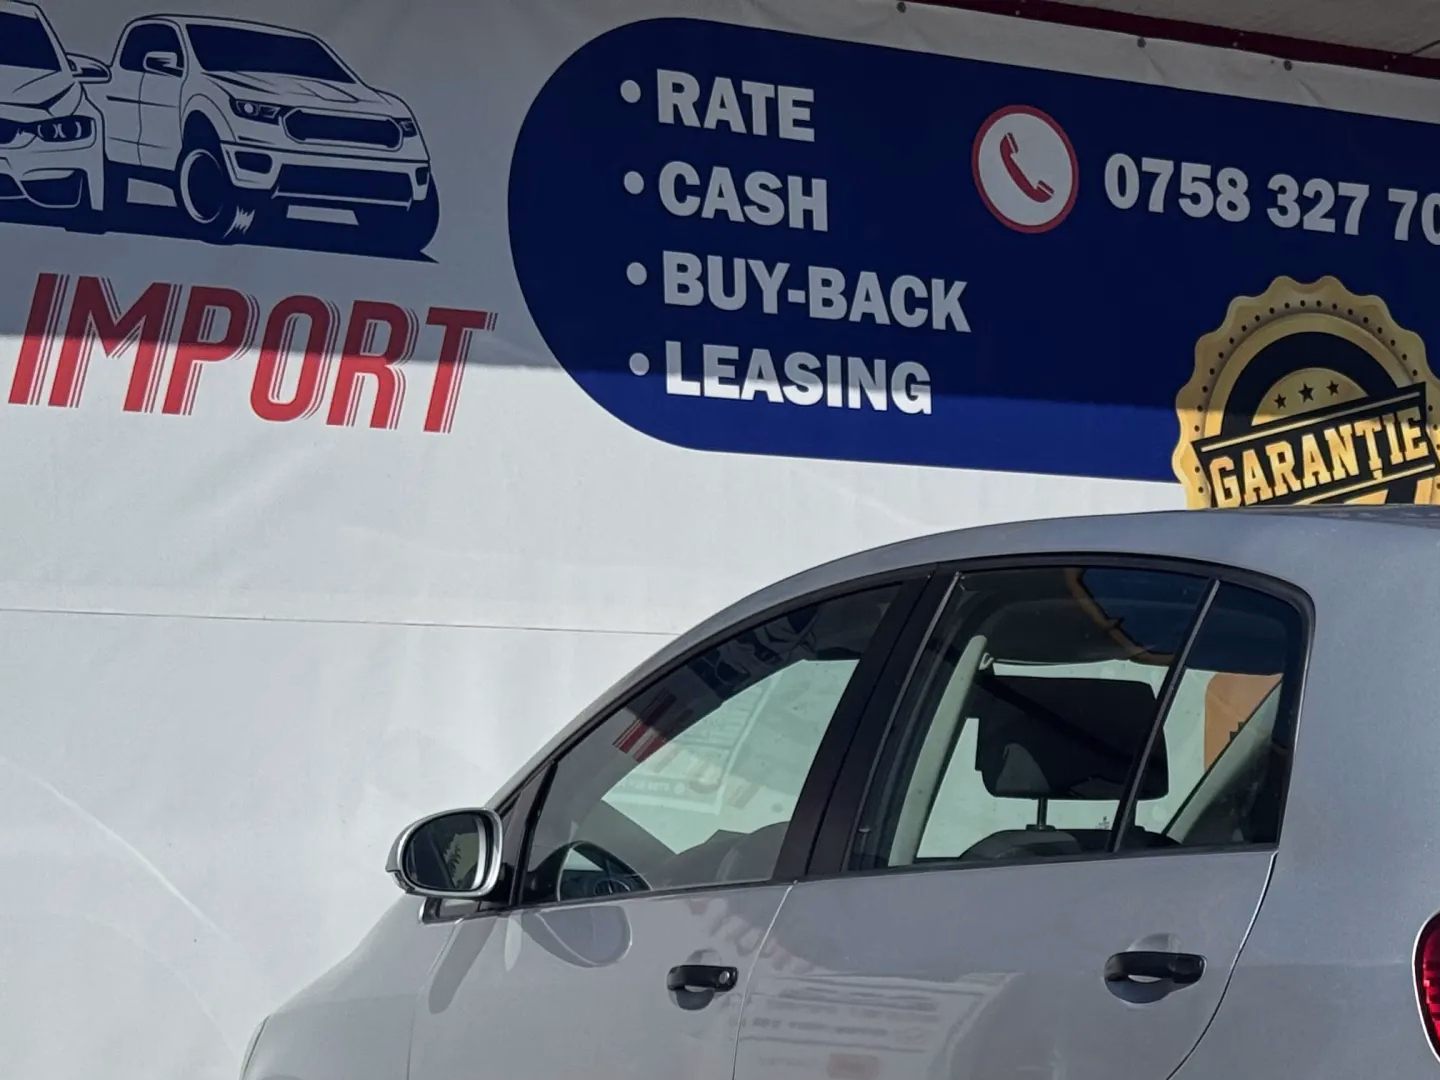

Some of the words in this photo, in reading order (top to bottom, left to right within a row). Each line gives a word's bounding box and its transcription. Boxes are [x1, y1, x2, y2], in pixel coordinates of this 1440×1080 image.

[657, 69, 815, 142] RATE
[659, 161, 828, 231] CASH
[1104, 153, 1250, 222] 0758
[1267, 174, 1370, 236] 327
[663, 250, 971, 332] BUY-BACK
[8, 273, 498, 433] IMPORT
[665, 340, 932, 414] LEASING
